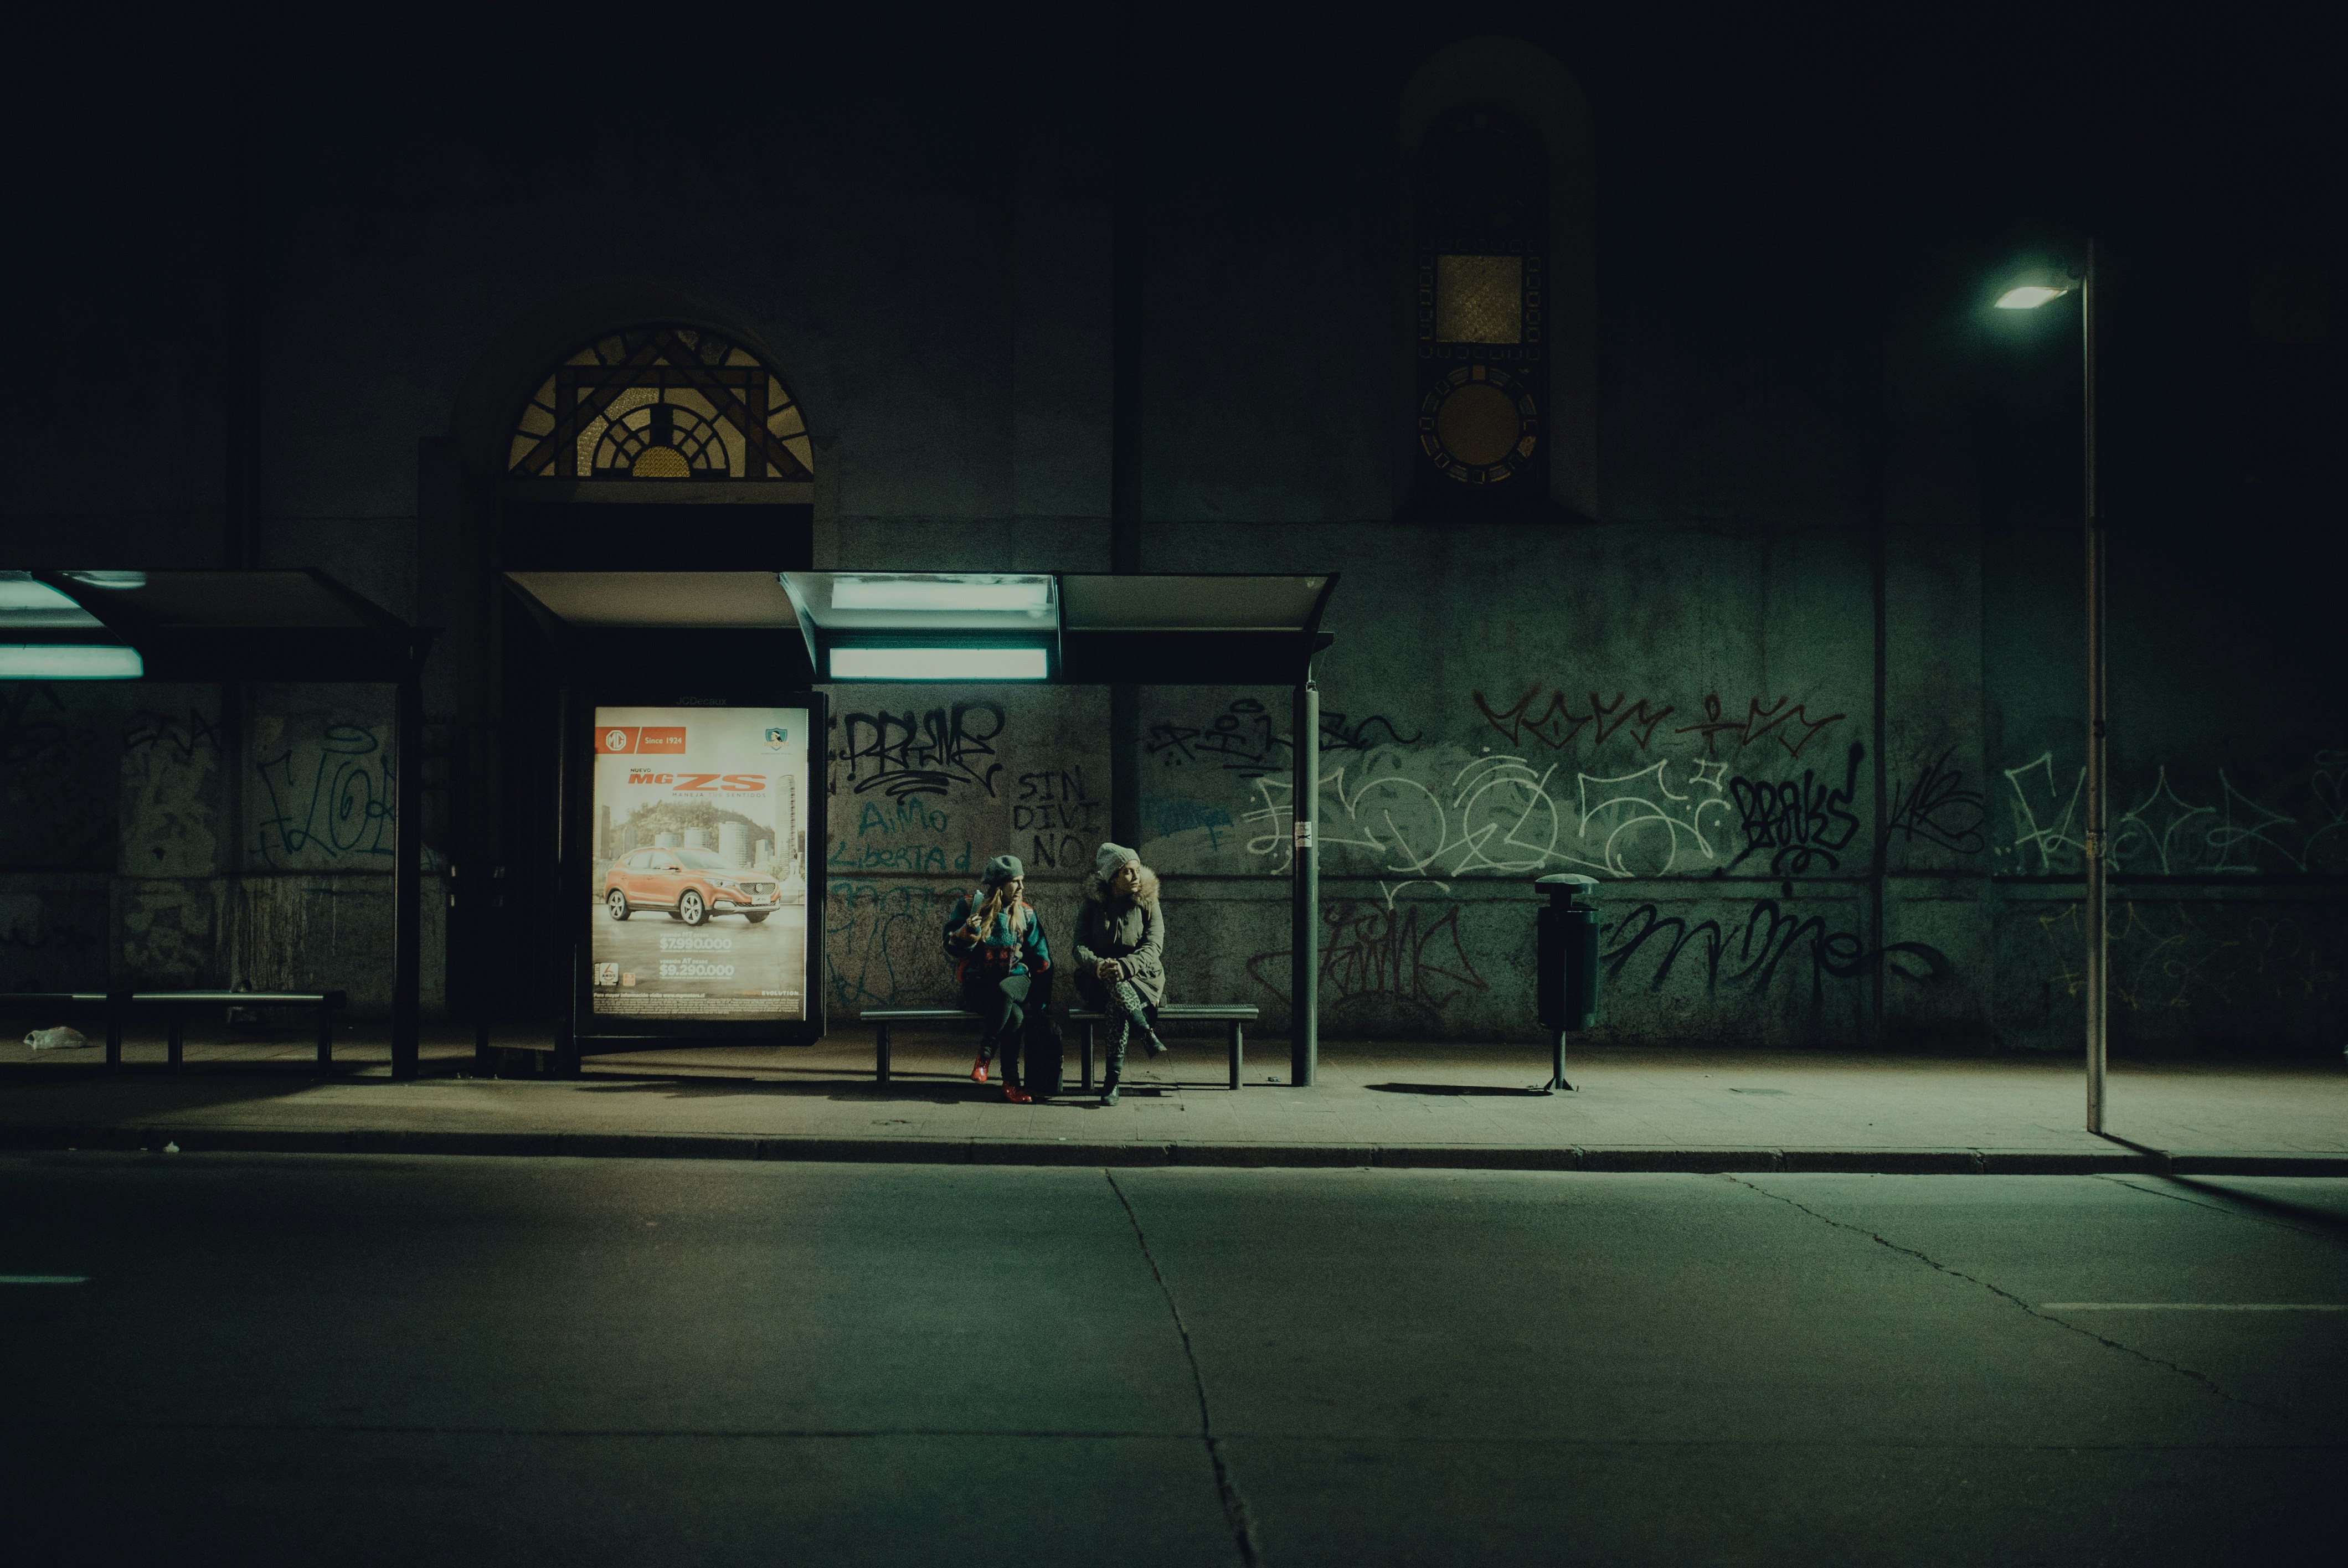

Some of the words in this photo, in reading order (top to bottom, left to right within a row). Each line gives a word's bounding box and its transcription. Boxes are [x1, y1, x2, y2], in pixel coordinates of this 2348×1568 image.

[676, 697, 727, 705] JCDecaux
[607, 731, 625, 750] MG
[628, 773, 674, 784] MG
[673, 773, 766, 791] ZS
[1018, 765, 1087, 802] SIN
[1013, 801, 1100, 833] DIVI
[1033, 833, 1085, 869] NO
[659, 937, 732, 950] $7.990.000
[659, 963, 735, 977] $9.290.000
